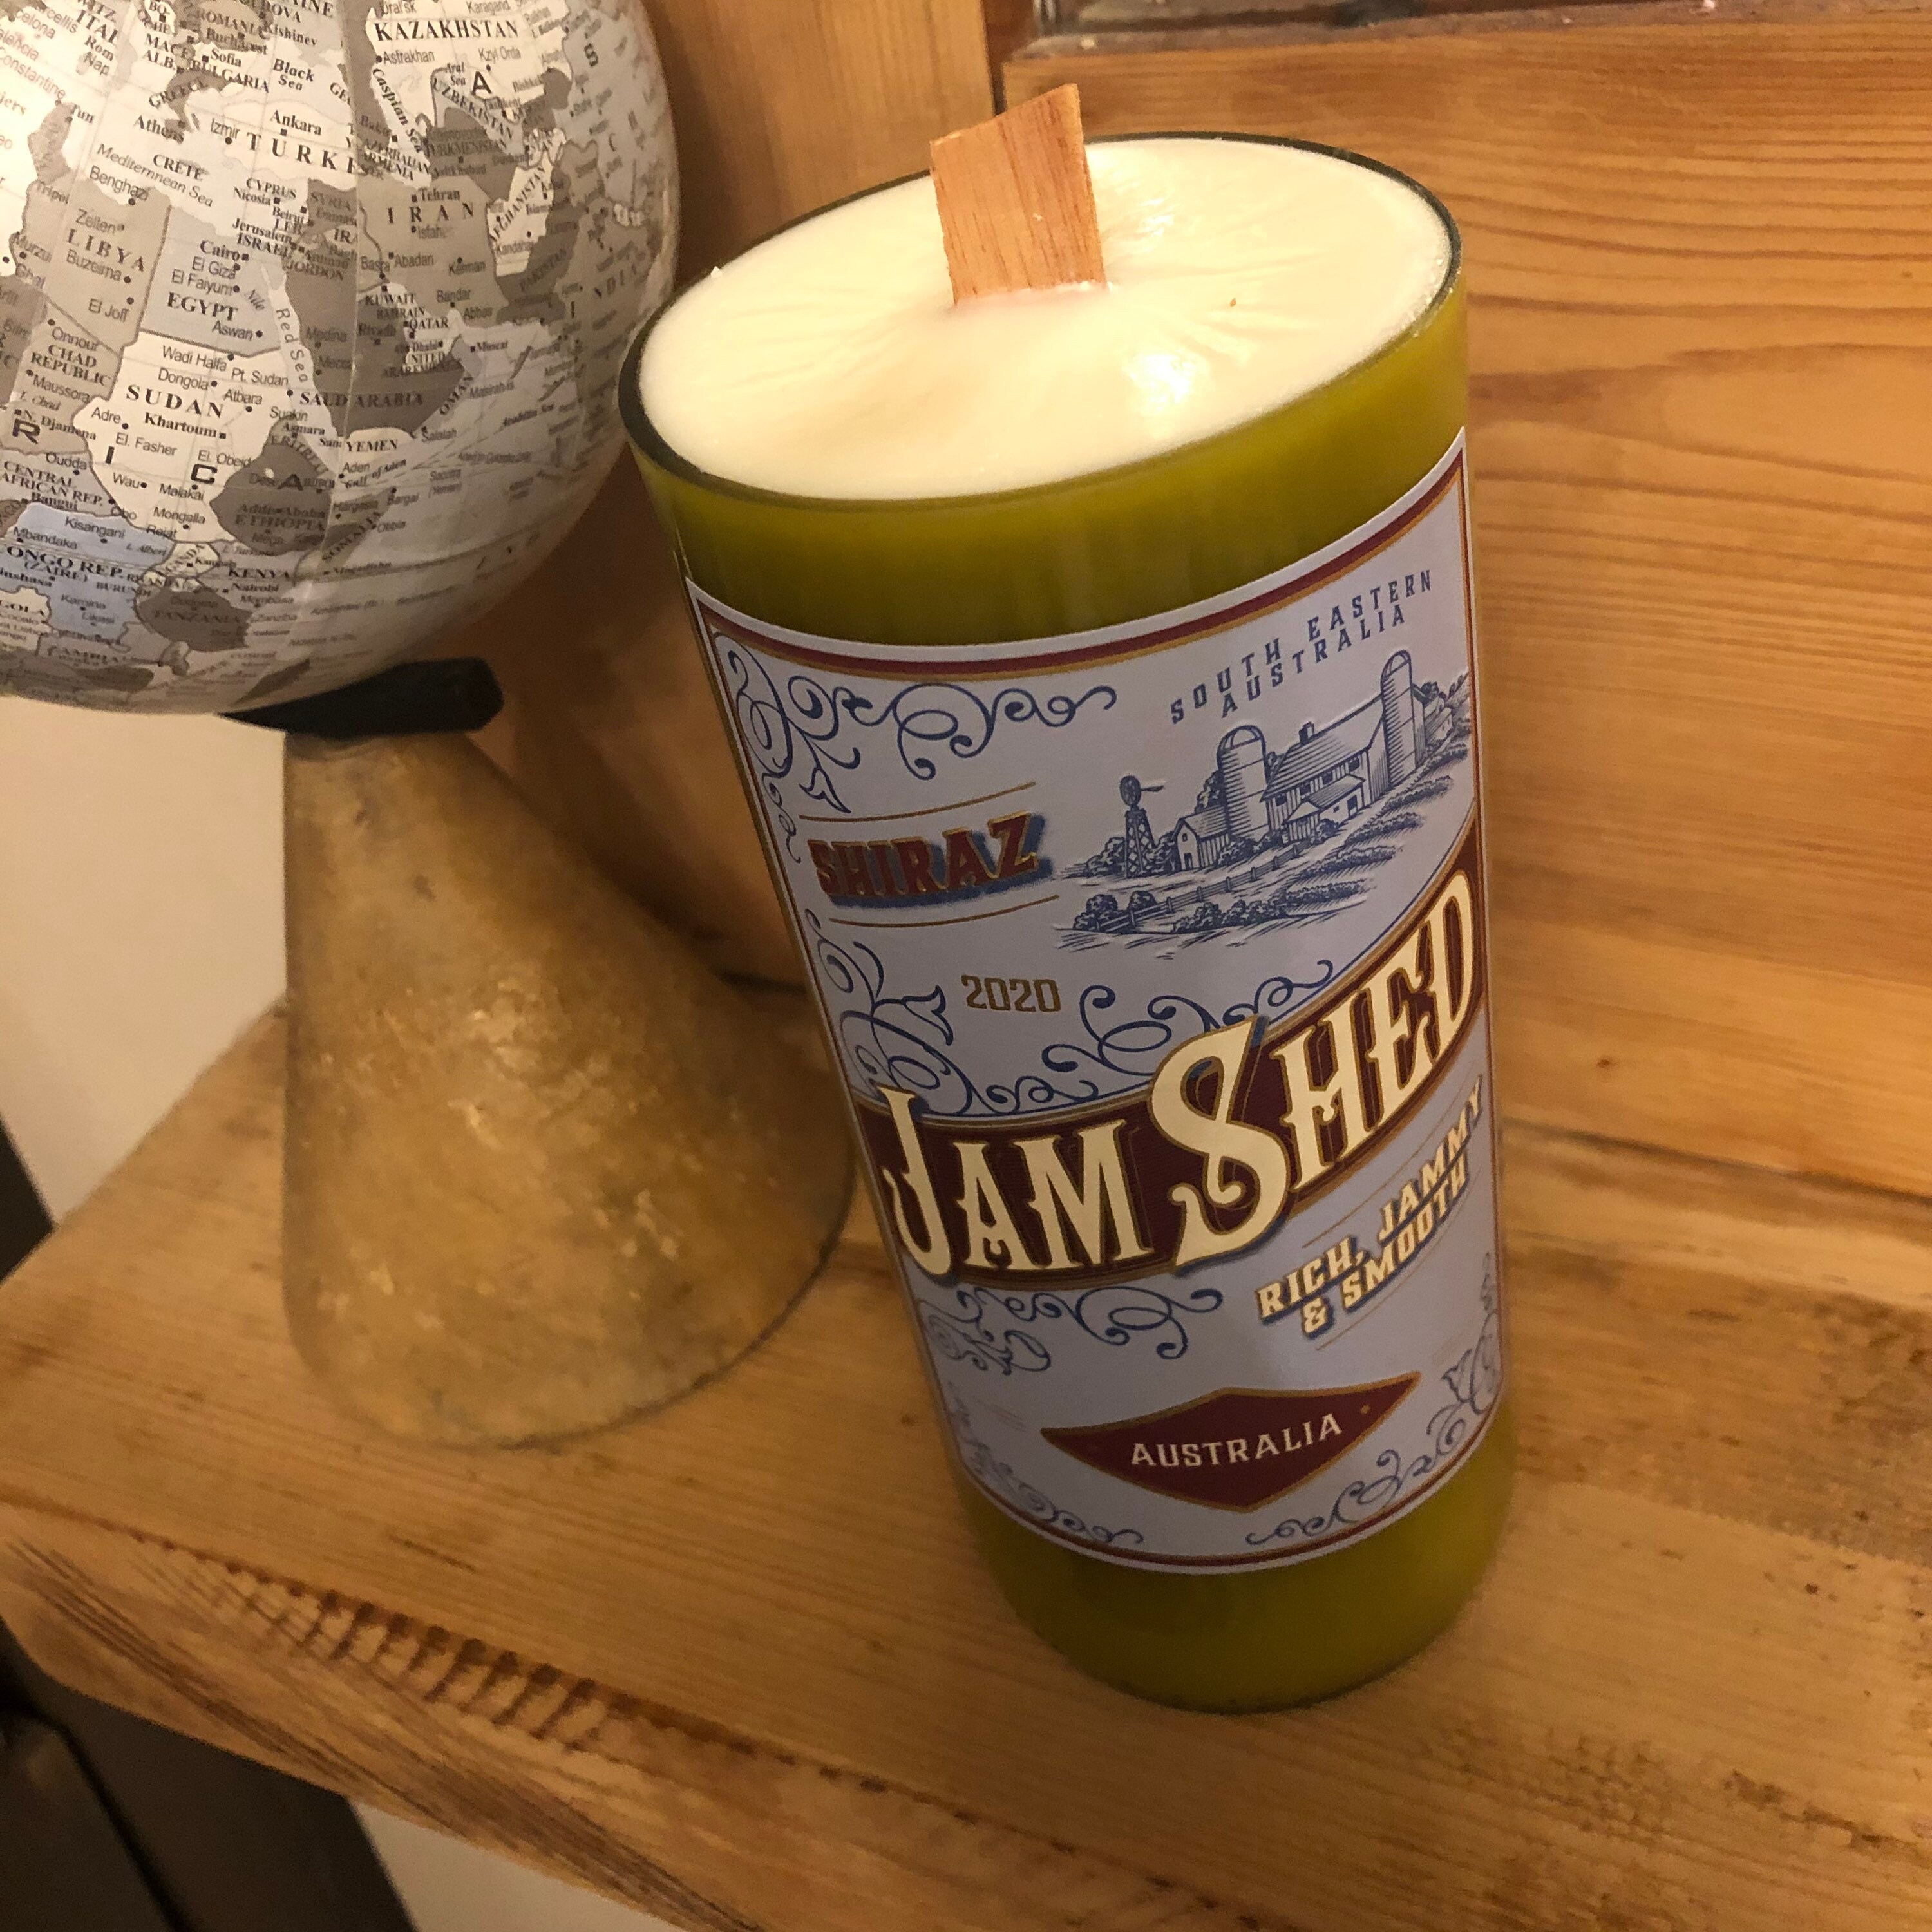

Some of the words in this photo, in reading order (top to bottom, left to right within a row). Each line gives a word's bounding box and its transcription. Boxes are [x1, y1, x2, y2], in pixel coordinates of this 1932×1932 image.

[374, 19, 519, 43] KAZAKHSTAN
[210, 47, 243, 68] Sofia
[272, 57, 316, 83] Black
[278, 74, 304, 91] Sea
[372, 68, 410, 126] Caspian
[210, 118, 242, 140] Izmir
[269, 109, 323, 137] Ankara
[153, 153, 205, 182] CRETE
[188, 185, 214, 207] Sea
[233, 186, 272, 206] Nicosia
[245, 176, 298, 200] CYPRUS
[419, 187, 460, 202] Tehran
[386, 200, 474, 225] IRAN
[67, 228, 146, 273] LIBYA
[200, 240, 241, 261] Cairo
[187, 272, 234, 296] Faiyum
[167, 291, 239, 323] EGYPT
[212, 319, 254, 341] Aswan
[408, 316, 450, 330] QATAR
[48, 344, 98, 369] CHAD
[162, 345, 193, 361] Wadi
[276, 307, 300, 345] Red
[289, 348, 310, 383] Sea
[30, 352, 111, 387] REPUBLIC
[157, 366, 209, 391] Dongola
[251, 369, 289, 388] Sudan
[126, 384, 224, 419] SUDAN
[223, 388, 263, 406] Atbara
[91, 406, 122, 424] Adre
[144, 412, 218, 439] Khartoum
[134, 436, 178, 457] Fasher
[345, 439, 399, 453] YEMEN
[3, 460, 78, 489] CENTRAL
[343, 462, 371, 473] Aden
[1, 472, 70, 498] AFRICAN
[113, 471, 140, 489] Wau
[153, 506, 206, 525] Mongalla
[13, 526, 78, 549] Mbandaka
[65, 516, 126, 540] Kisangani
[227, 567, 292, 580] KENYA
[1169, 637, 1282, 724] SOUTH
[1307, 569, 1432, 641] EASTERN
[1221, 603, 1406, 719] AUSTRALIA
[807, 810, 1050, 904] SHIRAZ
[961, 974, 1061, 1012] 2020
[878, 1082, 1158, 1278] JAM
[1148, 871, 1475, 1270] SHED
[1255, 1235, 1365, 1321] RICH,
[1378, 1074, 1482, 1244] JAMMY
[1301, 1295, 1332, 1337] &
[1341, 1150, 1470, 1311] SMOOTH
[1130, 1412, 1343, 1468] AUSTRALIA
